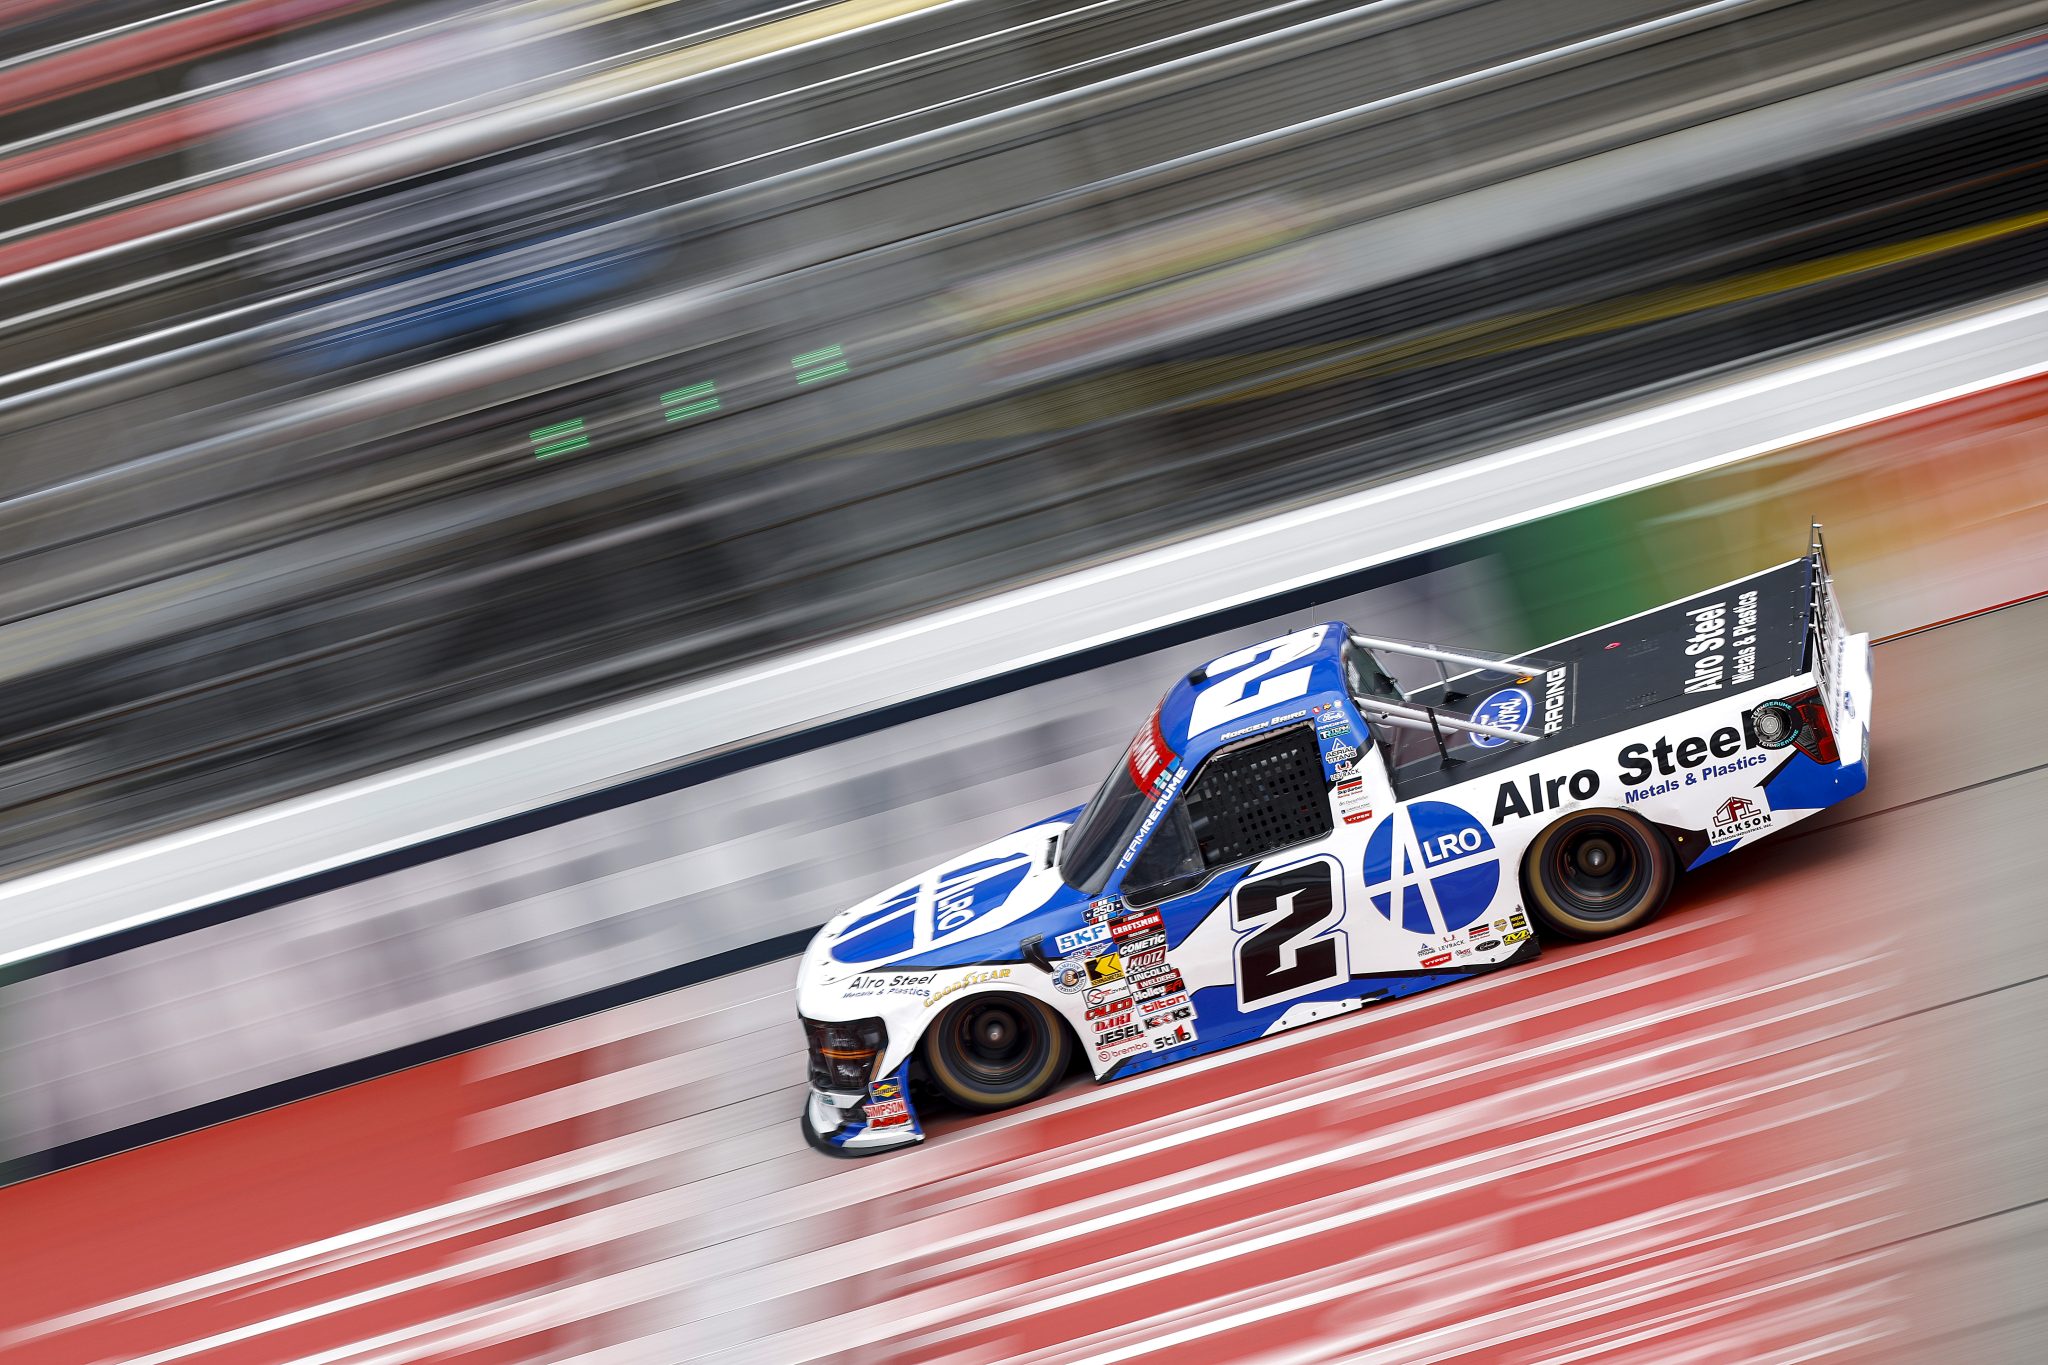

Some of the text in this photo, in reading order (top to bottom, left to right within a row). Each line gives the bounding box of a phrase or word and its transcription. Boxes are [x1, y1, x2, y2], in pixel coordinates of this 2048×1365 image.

[1684, 601, 1726, 694] Alro Steel
[1732, 590, 1758, 685] Metals & Plastics
[1187, 625, 1329, 740] 2
[1544, 666, 1566, 735] RACING
[1326, 746, 1356, 758] AERIAL
[1326, 752, 1357, 764] TITANS
[1331, 769, 1360, 781] LEVRACK
[1491, 709, 1761, 827] Alro Steel
[1625, 752, 1768, 804] Metals & Plastics
[1116, 766, 1188, 871] TEAMREAUME
[1711, 814, 1772, 839] JACKSON
[1092, 904, 1115, 918] 250
[1112, 915, 1160, 935] CRAFTSMAN
[1236, 860, 1338, 1005] 2
[1060, 925, 1107, 950] SKF
[1120, 934, 1166, 956] COMETIC
[1438, 940, 1465, 952] LEVRACK
[1129, 949, 1164, 968] KLOTZ
[849, 973, 938, 990] Alro Steel
[1129, 965, 1171, 984] LINCOLN
[1139, 973, 1177, 989] WELDERS
[888, 987, 931, 998] Plastics
[923, 968, 1012, 1008] GOODYEAR
[1133, 988, 1166, 1003] Holley
[1084, 997, 1133, 1021] CALICO
[1141, 994, 1187, 1013] tilton
[1095, 1024, 1144, 1046] JESEL
[1153, 1025, 1192, 1050] Stilo
[1111, 1043, 1149, 1058] brembo
[866, 1100, 905, 1118] SIMPSON
